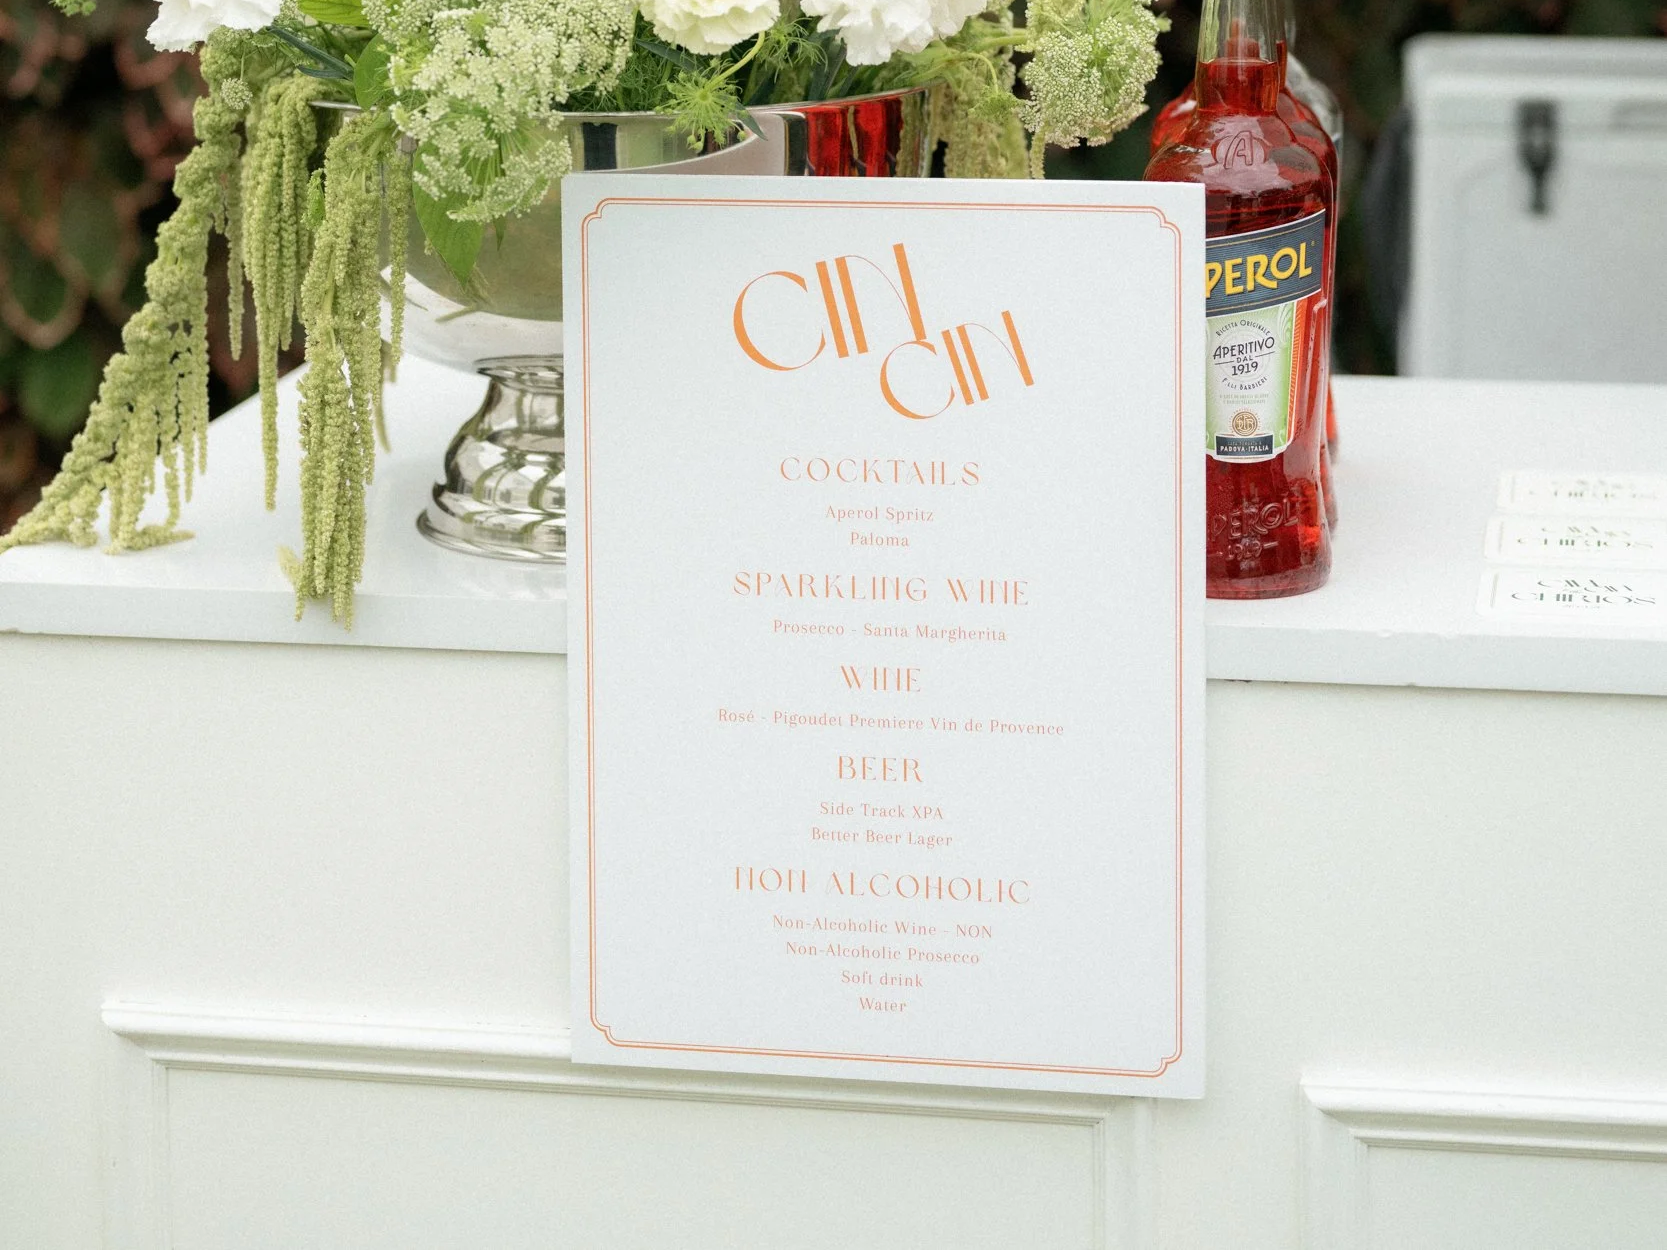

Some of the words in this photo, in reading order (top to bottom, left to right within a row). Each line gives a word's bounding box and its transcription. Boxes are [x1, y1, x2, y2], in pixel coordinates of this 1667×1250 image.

[1205, 242, 1312, 300] PEROL
[733, 242, 928, 372] CIN
[1215, 321, 1239, 337] RICETTA
[1240, 319, 1271, 336] ORIGINALE
[1212, 336, 1275, 360] APERITIVO
[1236, 354, 1254, 364] DAL
[880, 310, 1035, 420] CIN
[1231, 361, 1259, 377] 1919
[1239, 376, 1268, 391] BARBIERI
[780, 455, 982, 488] COCKTAILS
[825, 505, 879, 523] Aperol
[885, 506, 935, 523] Spritz
[1205, 498, 1299, 542] PEROL
[849, 531, 910, 548] Paloma
[733, 570, 929, 604] SPARKLING
[946, 576, 1030, 608] WINE
[772, 618, 845, 636] Prosecco
[863, 622, 910, 639] Santa
[915, 623, 1008, 645] Margherita
[839, 664, 923, 694] WINE
[718, 707, 756, 724] Rosé
[773, 710, 844, 730] Pigoudet
[849, 713, 925, 731] Premiere
[930, 715, 959, 732] Vin
[964, 717, 984, 734] de
[989, 719, 1065, 737] Provence
[837, 754, 924, 784] BEER
[820, 800, 855, 816] Side
[860, 803, 906, 820] Track
[911, 805, 944, 821] XPA
[810, 826, 860, 843] Better
[865, 829, 902, 845] Beer
[907, 831, 954, 850] Lager
[735, 864, 808, 895] NON
[825, 870, 1032, 906] ALCOHOLIC
[772, 913, 888, 935] Non-Alcoholic
[894, 919, 938, 937] Wine
[955, 923, 994, 940] NON
[785, 941, 902, 962] Non-Alcoholic
[907, 947, 981, 965] Prosecco
[841, 970, 874, 987] Soft
[879, 972, 924, 989] drink
[858, 996, 909, 1014] Water
